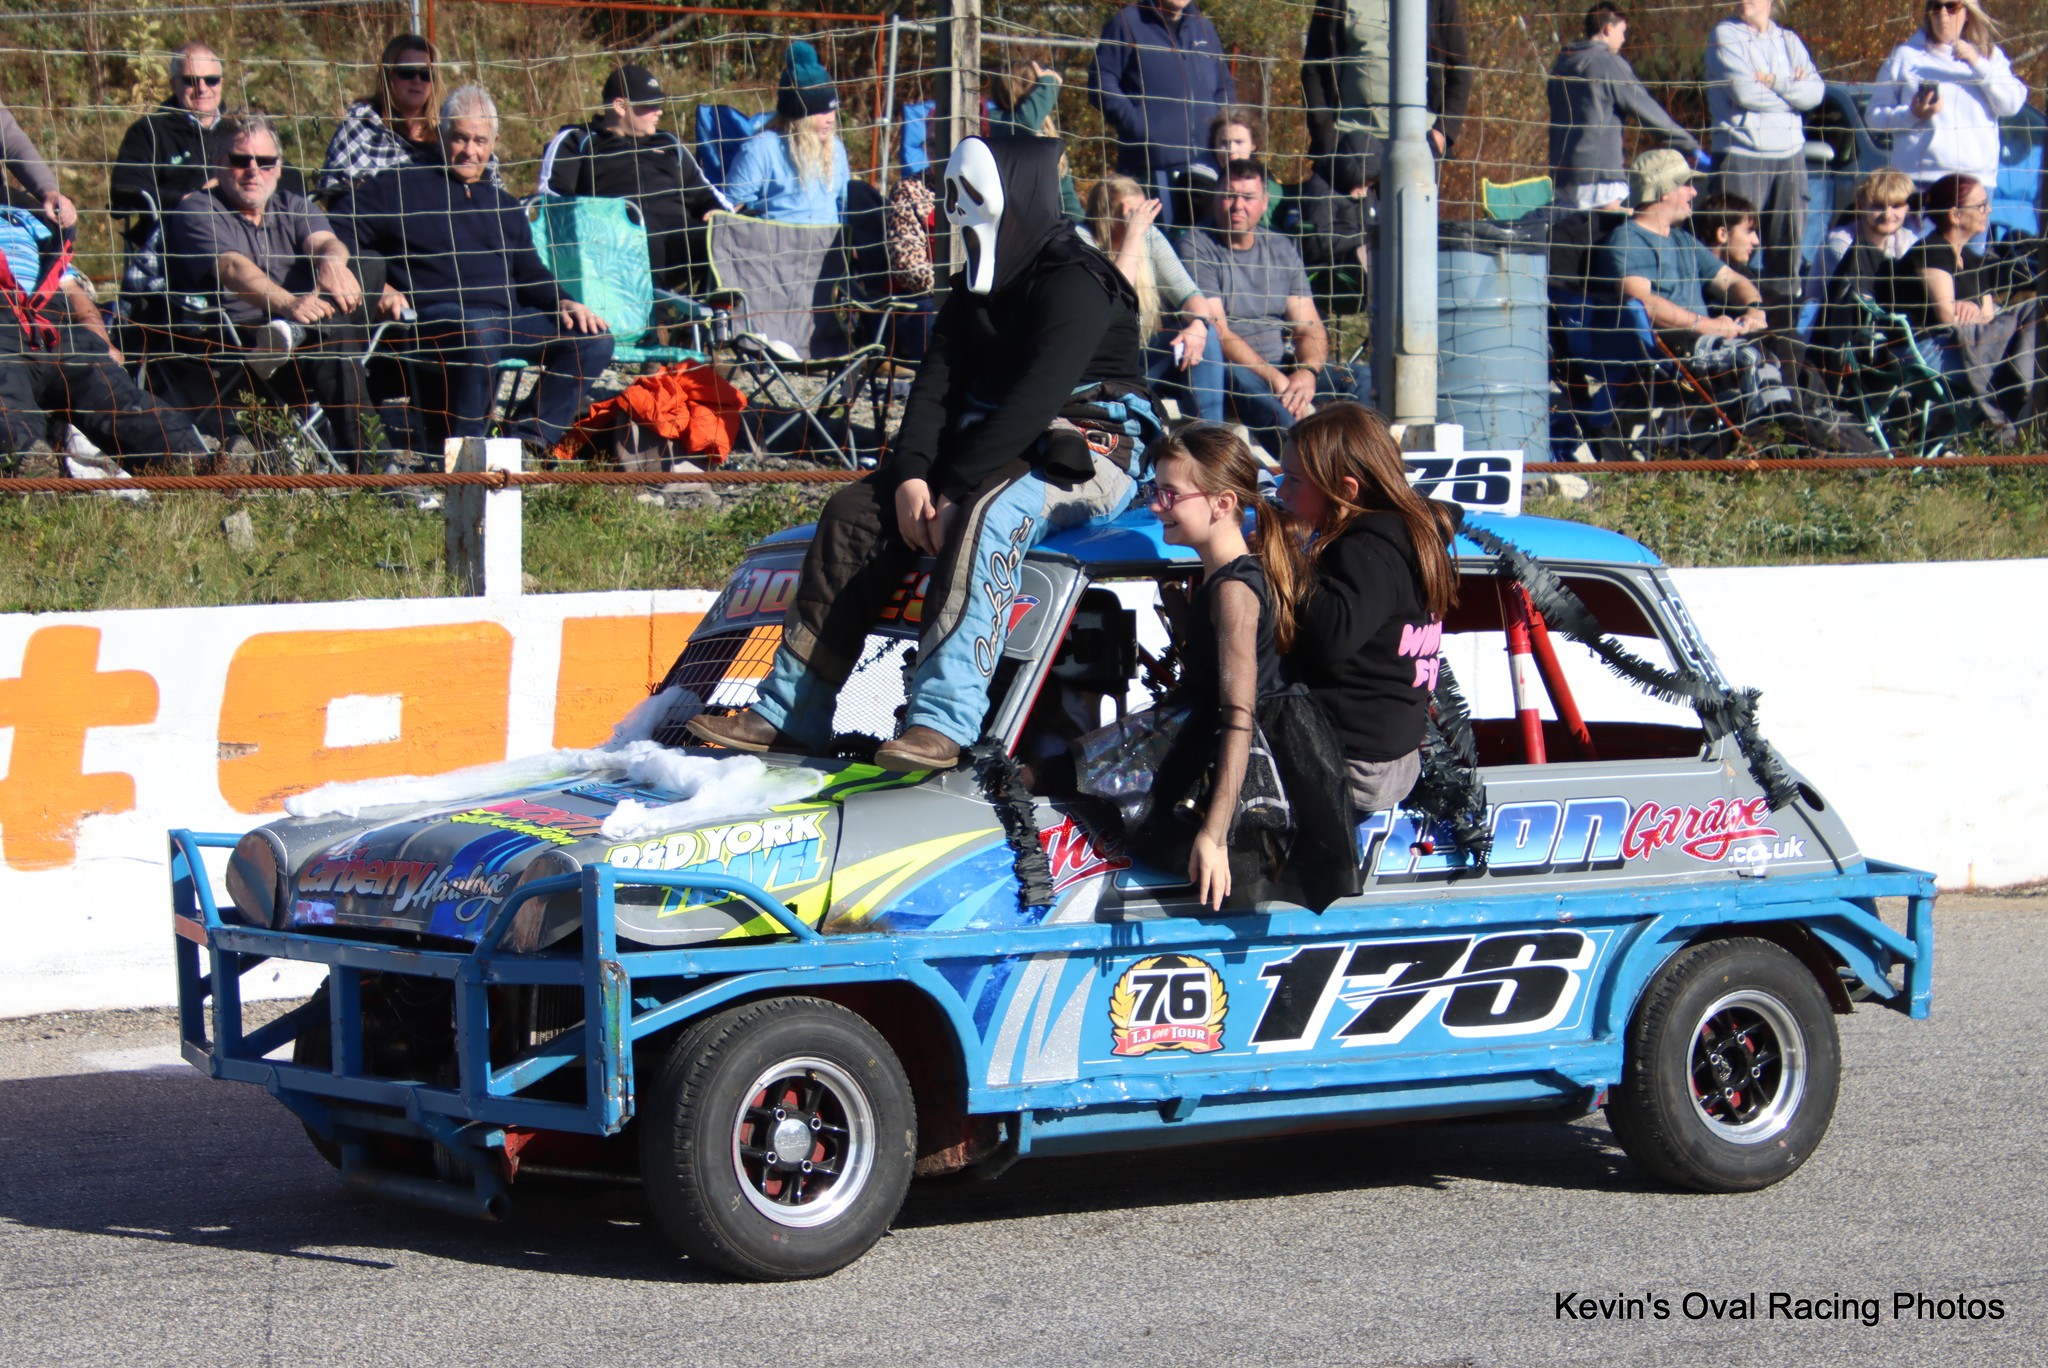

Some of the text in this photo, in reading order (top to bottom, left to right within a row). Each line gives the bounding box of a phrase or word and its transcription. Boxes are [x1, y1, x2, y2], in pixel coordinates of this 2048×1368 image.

[702, 812, 824, 863] YORK
[1621, 796, 1779, 863] Garage
[663, 838, 820, 913] TRAVEL
[1130, 970, 1209, 1024] 76
[1249, 929, 1592, 1050] 176
[1152, 1028, 1171, 1040] on
